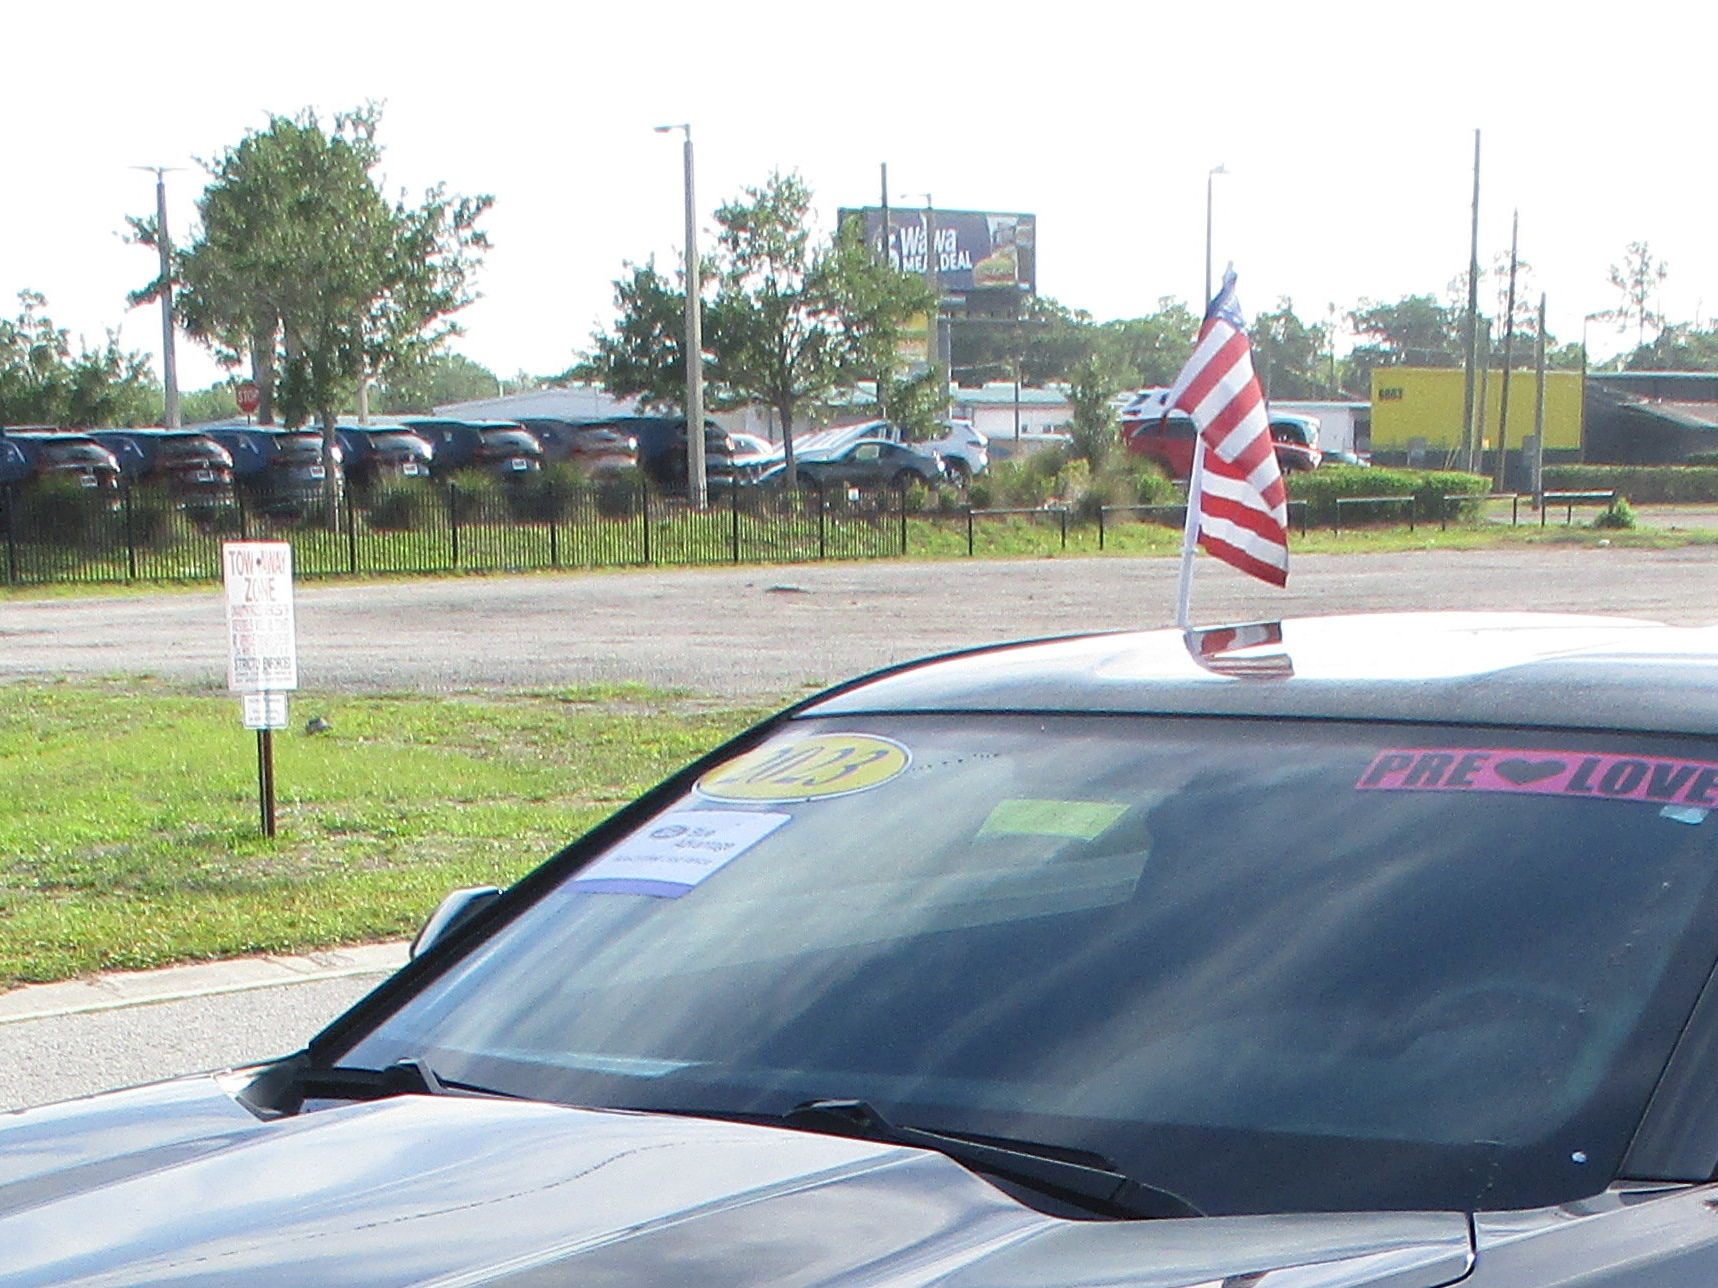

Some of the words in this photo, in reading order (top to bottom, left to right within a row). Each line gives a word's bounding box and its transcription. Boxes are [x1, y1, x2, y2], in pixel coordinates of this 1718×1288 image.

[940, 250, 973, 272] DEAL
[237, 389, 260, 403] STOP
[228, 550, 253, 576] TOW
[244, 577, 276, 603] ZONE
[713, 746, 888, 787] 2023
[1362, 752, 1491, 788] PRE
